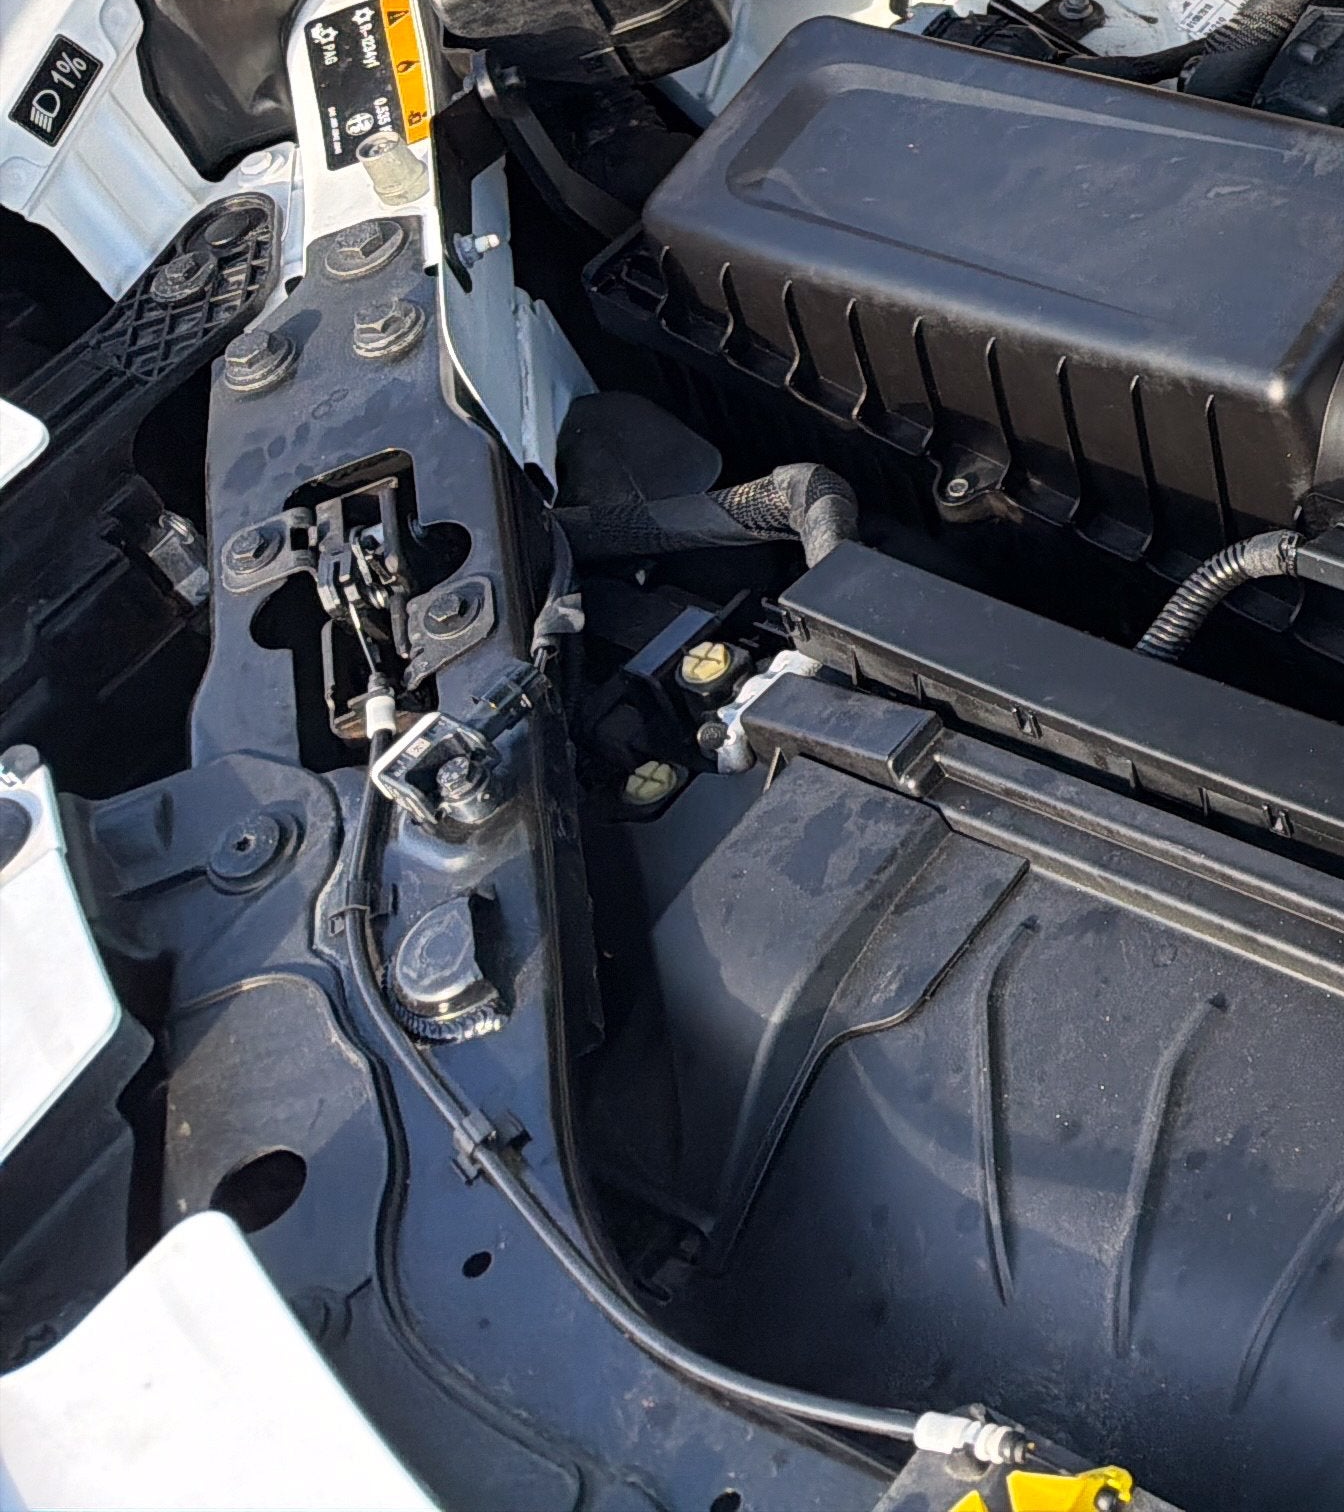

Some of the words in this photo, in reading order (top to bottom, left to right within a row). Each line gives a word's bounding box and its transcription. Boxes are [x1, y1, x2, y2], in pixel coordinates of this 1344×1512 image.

[322, 41, 339, 66] PAG
[50, 50, 87, 90] 1%
[373, 96, 392, 128] 0.535
